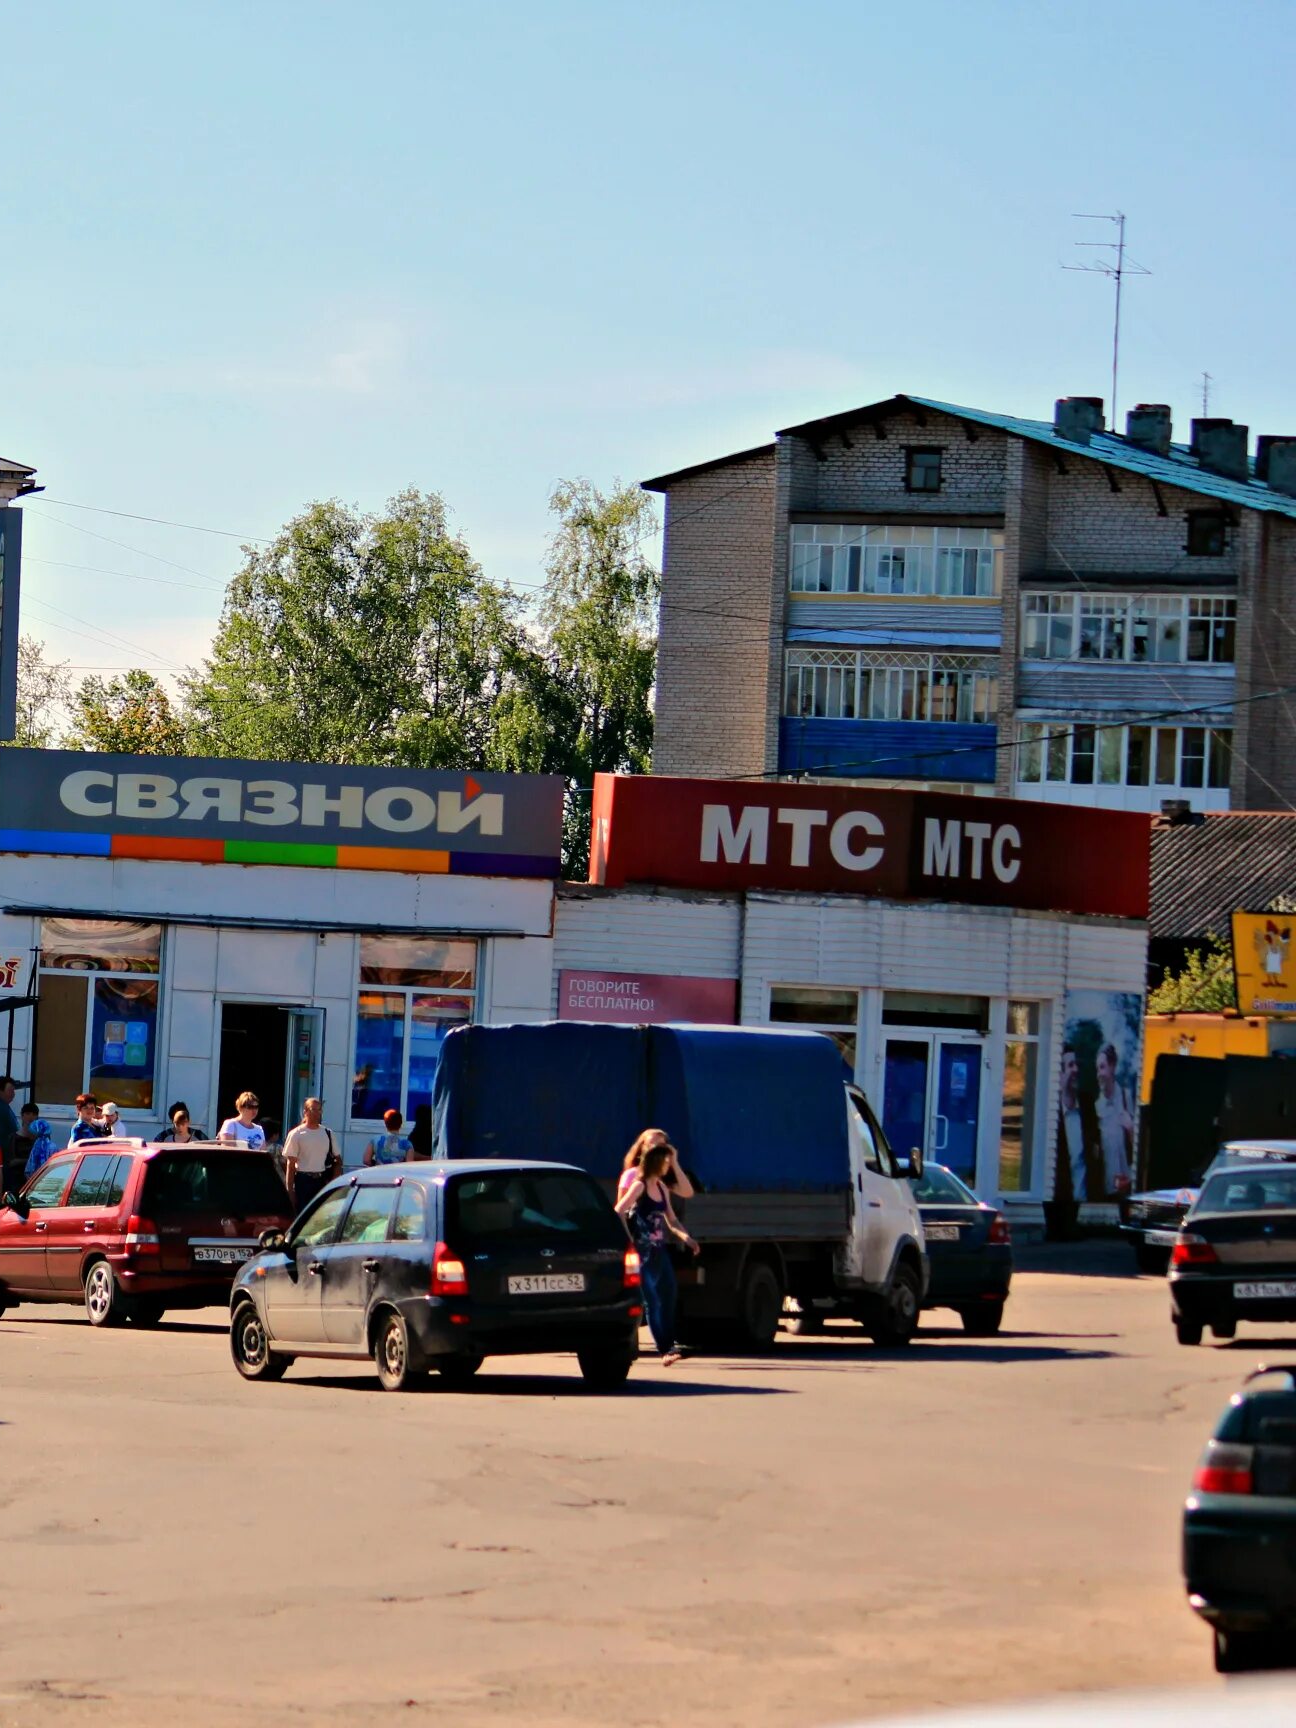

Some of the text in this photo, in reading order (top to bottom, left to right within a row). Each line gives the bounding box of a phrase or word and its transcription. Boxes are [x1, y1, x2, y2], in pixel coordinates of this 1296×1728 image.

[59, 769, 505, 837] СВЯЗНОЙ
[699, 804, 1022, 884] МТС МТС
[568, 995, 654, 1011] БЕСПЛАТНО!
[569, 979, 640, 995] ГОВОРИТЕ
